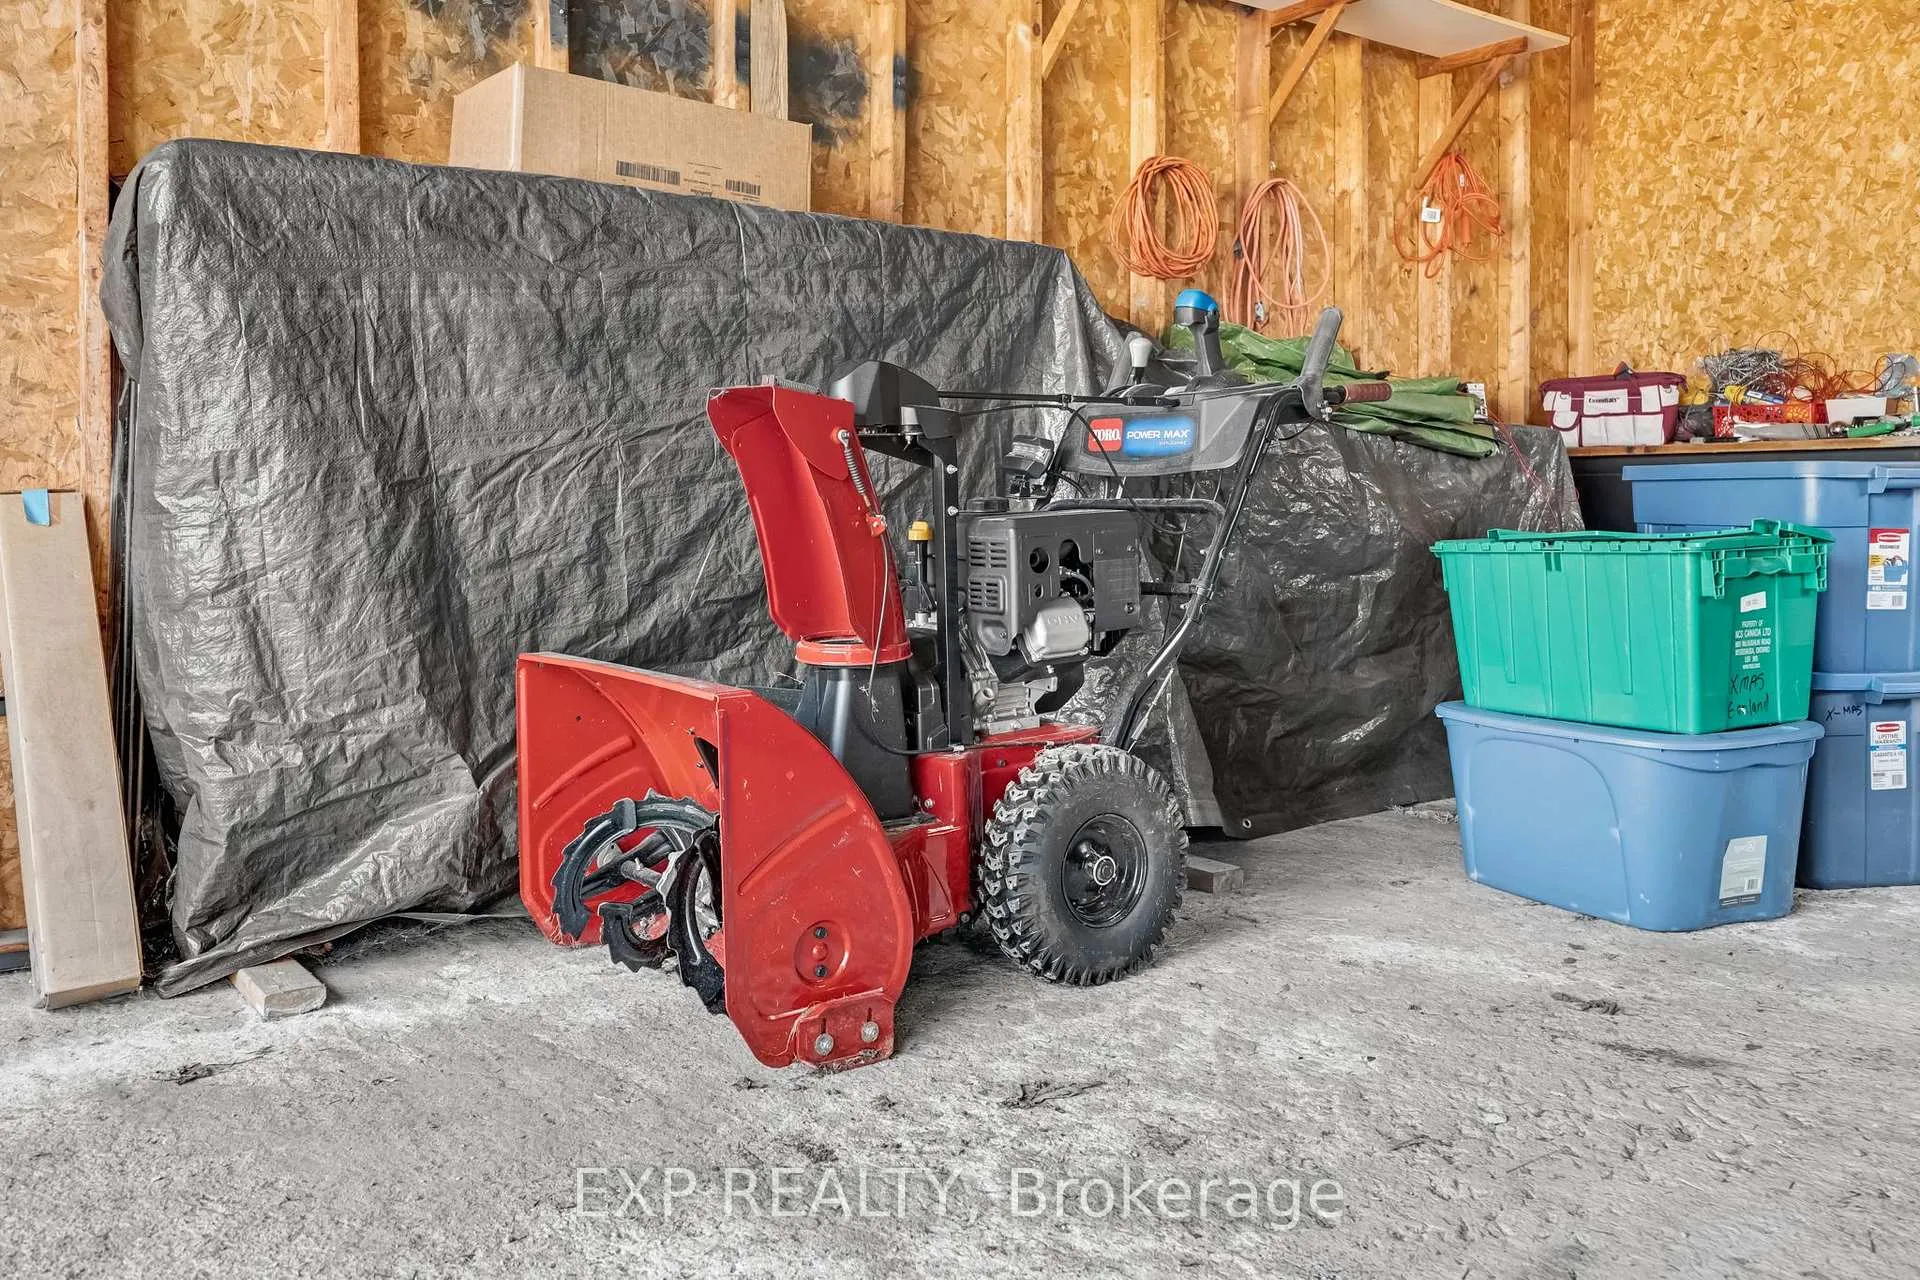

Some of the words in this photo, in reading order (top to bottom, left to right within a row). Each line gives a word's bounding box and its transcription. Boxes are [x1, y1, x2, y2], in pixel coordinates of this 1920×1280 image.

[1093, 429, 1121, 442] TORO
[1126, 430, 1161, 440] POWER
[1163, 429, 1189, 439] MAX
